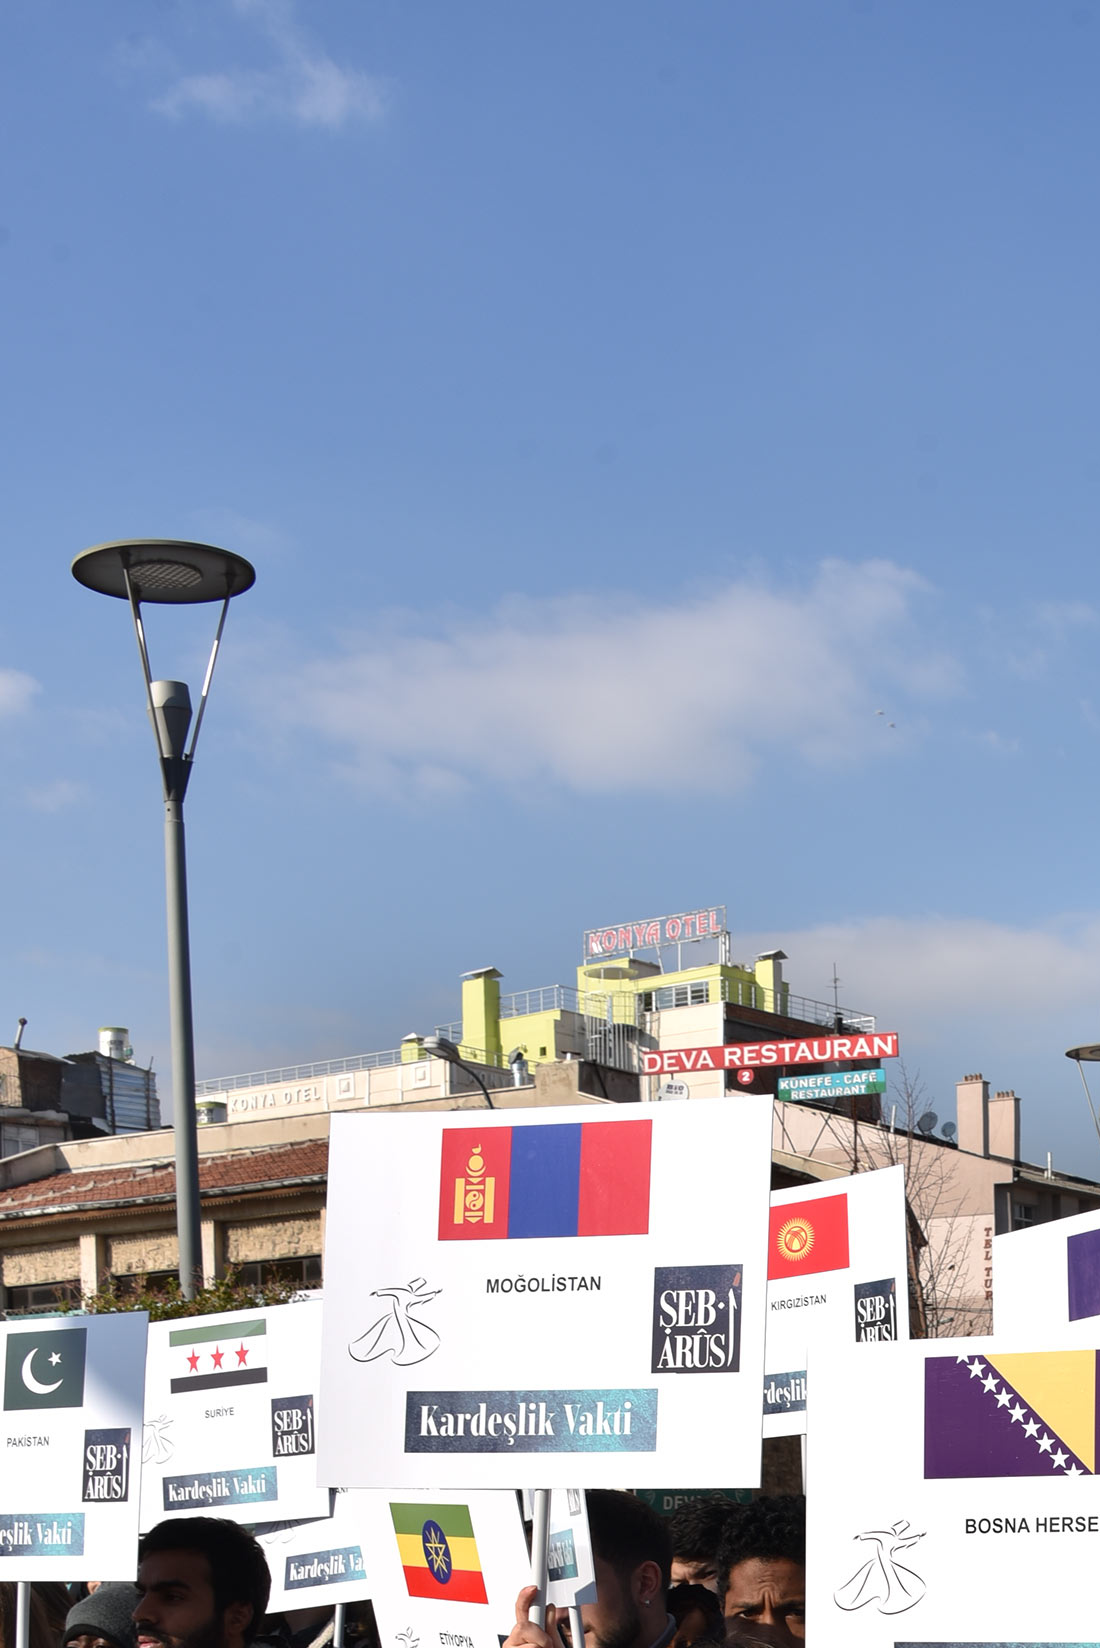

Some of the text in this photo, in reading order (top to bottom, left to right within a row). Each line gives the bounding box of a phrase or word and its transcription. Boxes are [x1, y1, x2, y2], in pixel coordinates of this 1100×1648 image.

[588, 911, 722, 956] KONYA OTEL
[643, 1035, 898, 1074] DEVA RESTAURAN
[740, 1071, 751, 1082] 2
[780, 1076, 832, 1091] KÜNEFE
[843, 1071, 878, 1084] CAFE
[230, 1086, 321, 1113] KONYA OTEL
[790, 1084, 867, 1100] RESTAURANT
[486, 1274, 602, 1294] MOĞOLİSTAN
[771, 1294, 828, 1311] KIRGIZİSTAN
[204, 1407, 235, 1419] SURİYE
[419, 1401, 633, 1446] Kardeşlik Vakti
[6, 1435, 50, 1448] PAKİSTAN
[168, 1473, 266, 1503] Kardeşlik Vakti
[35, 1521, 72, 1545] Vakti
[964, 1517, 1030, 1535] BOSNA
[288, 1554, 346, 1581] Kardeşlik
[439, 1630, 475, 1648] ETİYOPYA
